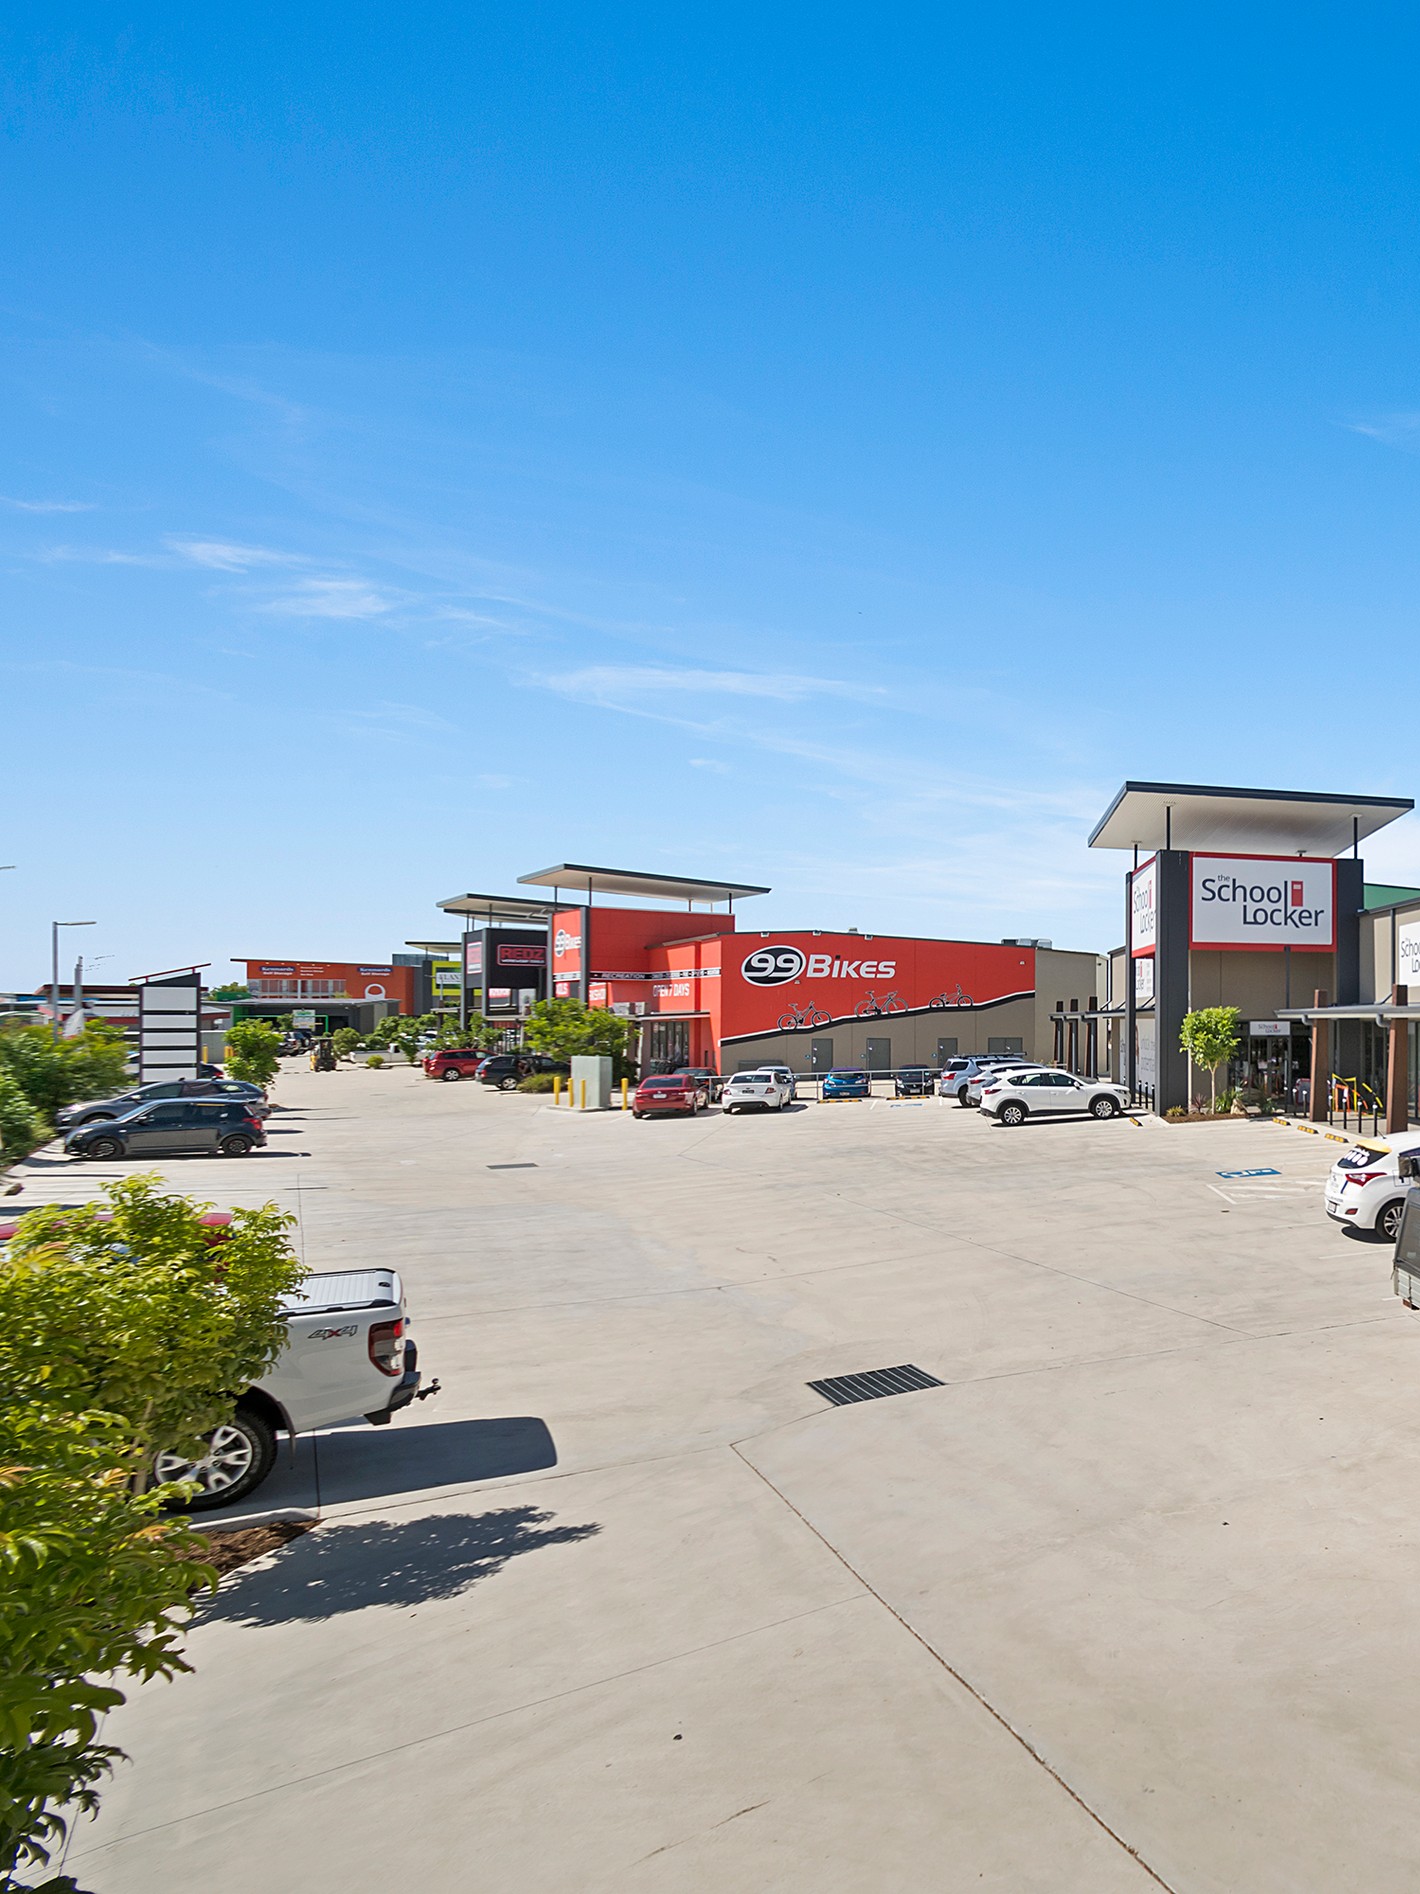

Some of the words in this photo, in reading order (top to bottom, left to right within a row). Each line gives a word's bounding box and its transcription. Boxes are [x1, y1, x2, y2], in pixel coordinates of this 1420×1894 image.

[1217, 874, 1231, 882] the
[1201, 878, 1288, 904] School
[1242, 904, 1325, 928] Locker
[744, 953, 801, 978] 99
[673, 983, 690, 997] DAYS
